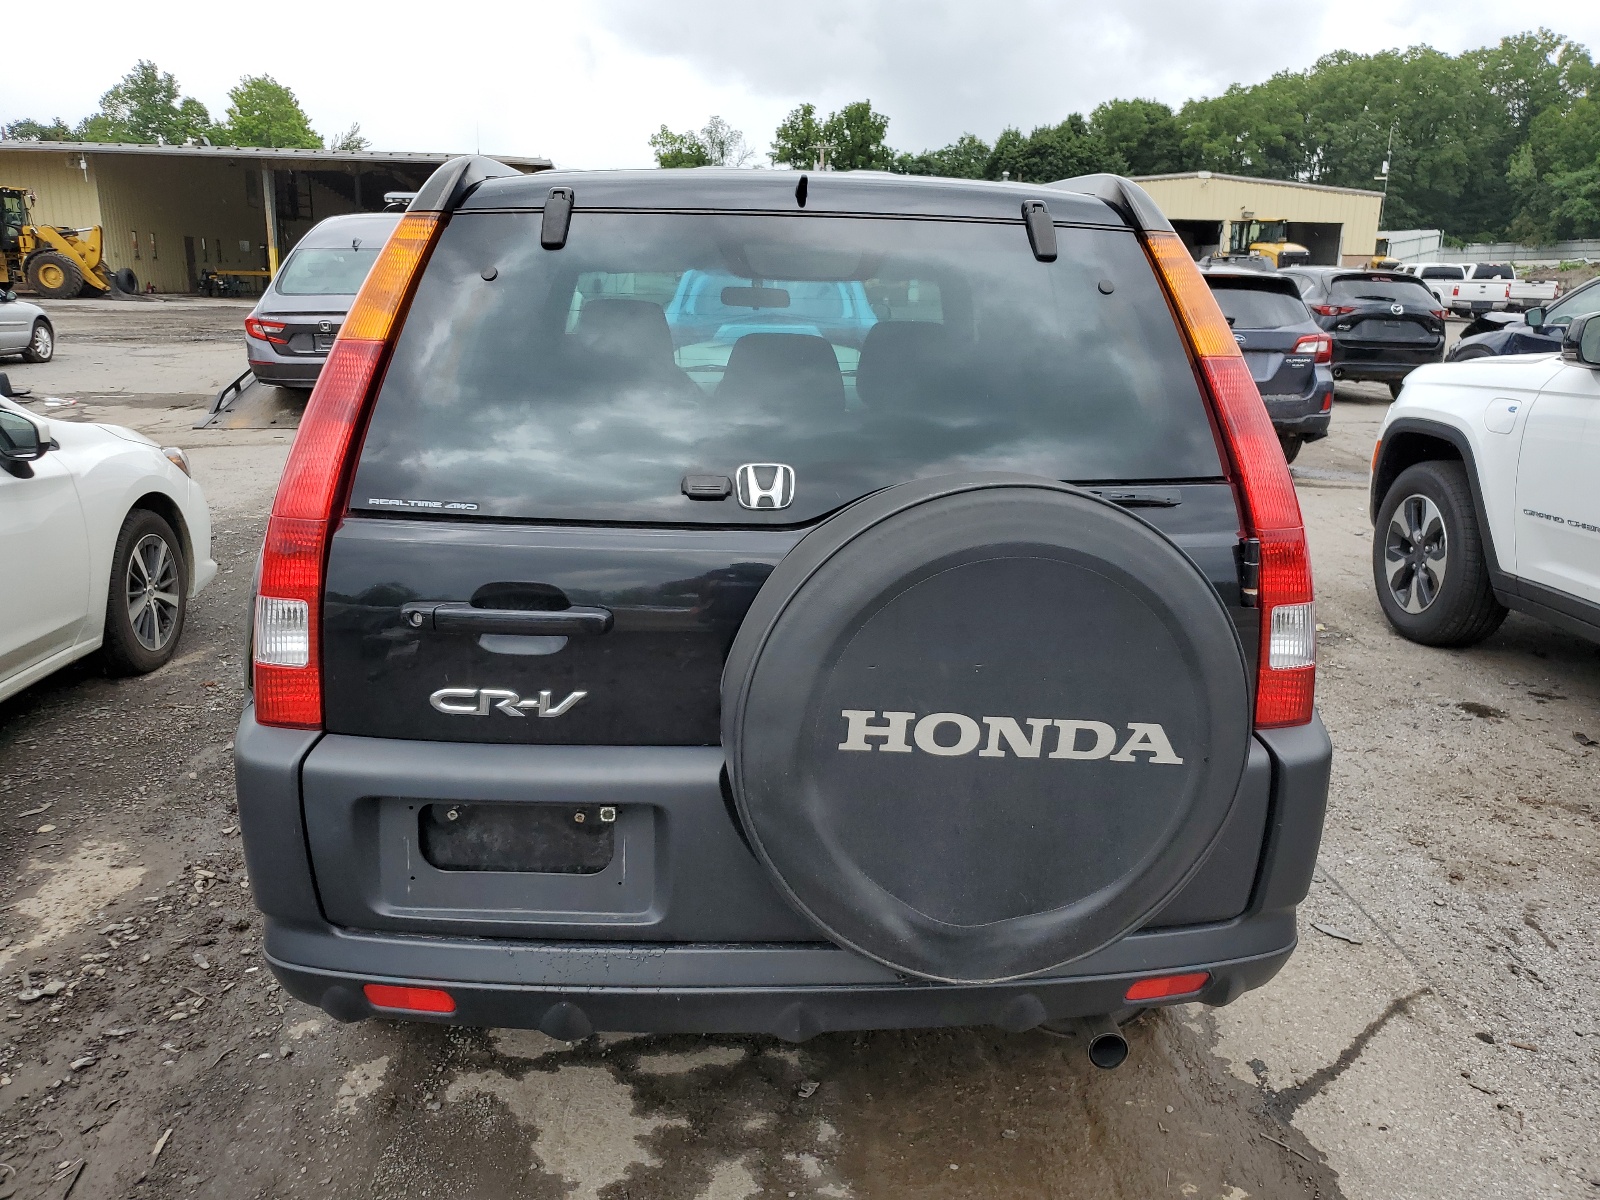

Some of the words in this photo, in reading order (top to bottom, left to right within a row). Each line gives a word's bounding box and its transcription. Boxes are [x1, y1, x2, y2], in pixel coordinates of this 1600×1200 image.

[444, 502, 478, 510] 4WD
[429, 688, 588, 718] CR-V
[838, 709, 1184, 765] HONDA
